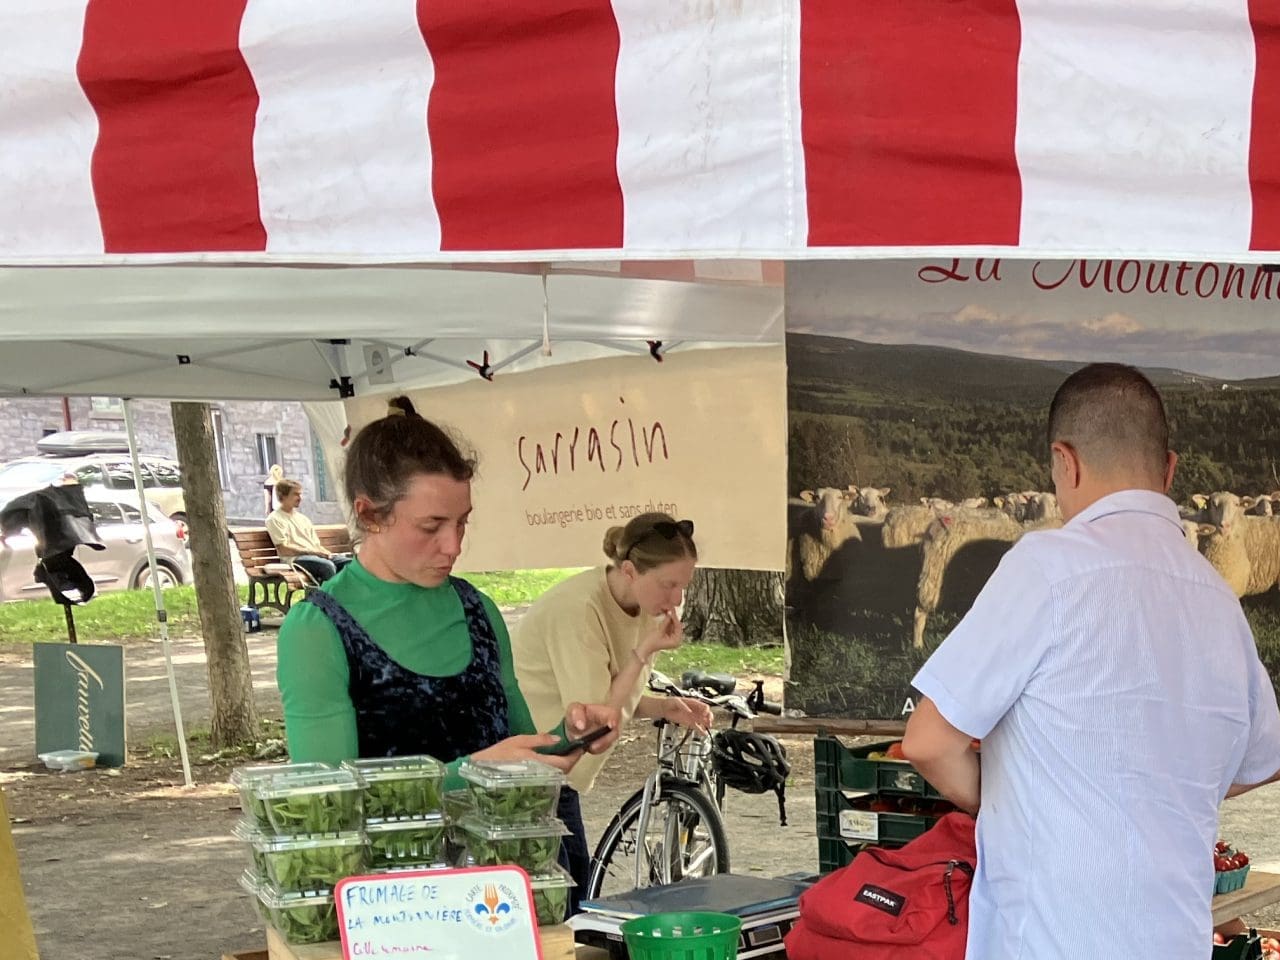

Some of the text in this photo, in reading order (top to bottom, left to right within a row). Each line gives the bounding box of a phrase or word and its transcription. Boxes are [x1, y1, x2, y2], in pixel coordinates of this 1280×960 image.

[525, 507, 584, 528] boulangerie
[584, 504, 603, 521] bio
[605, 505, 617, 520] et
[619, 501, 642, 518] sans
[421, 884, 439, 900] DE
[862, 889, 898, 908] EASTPAK
[348, 917, 365, 930] LA
